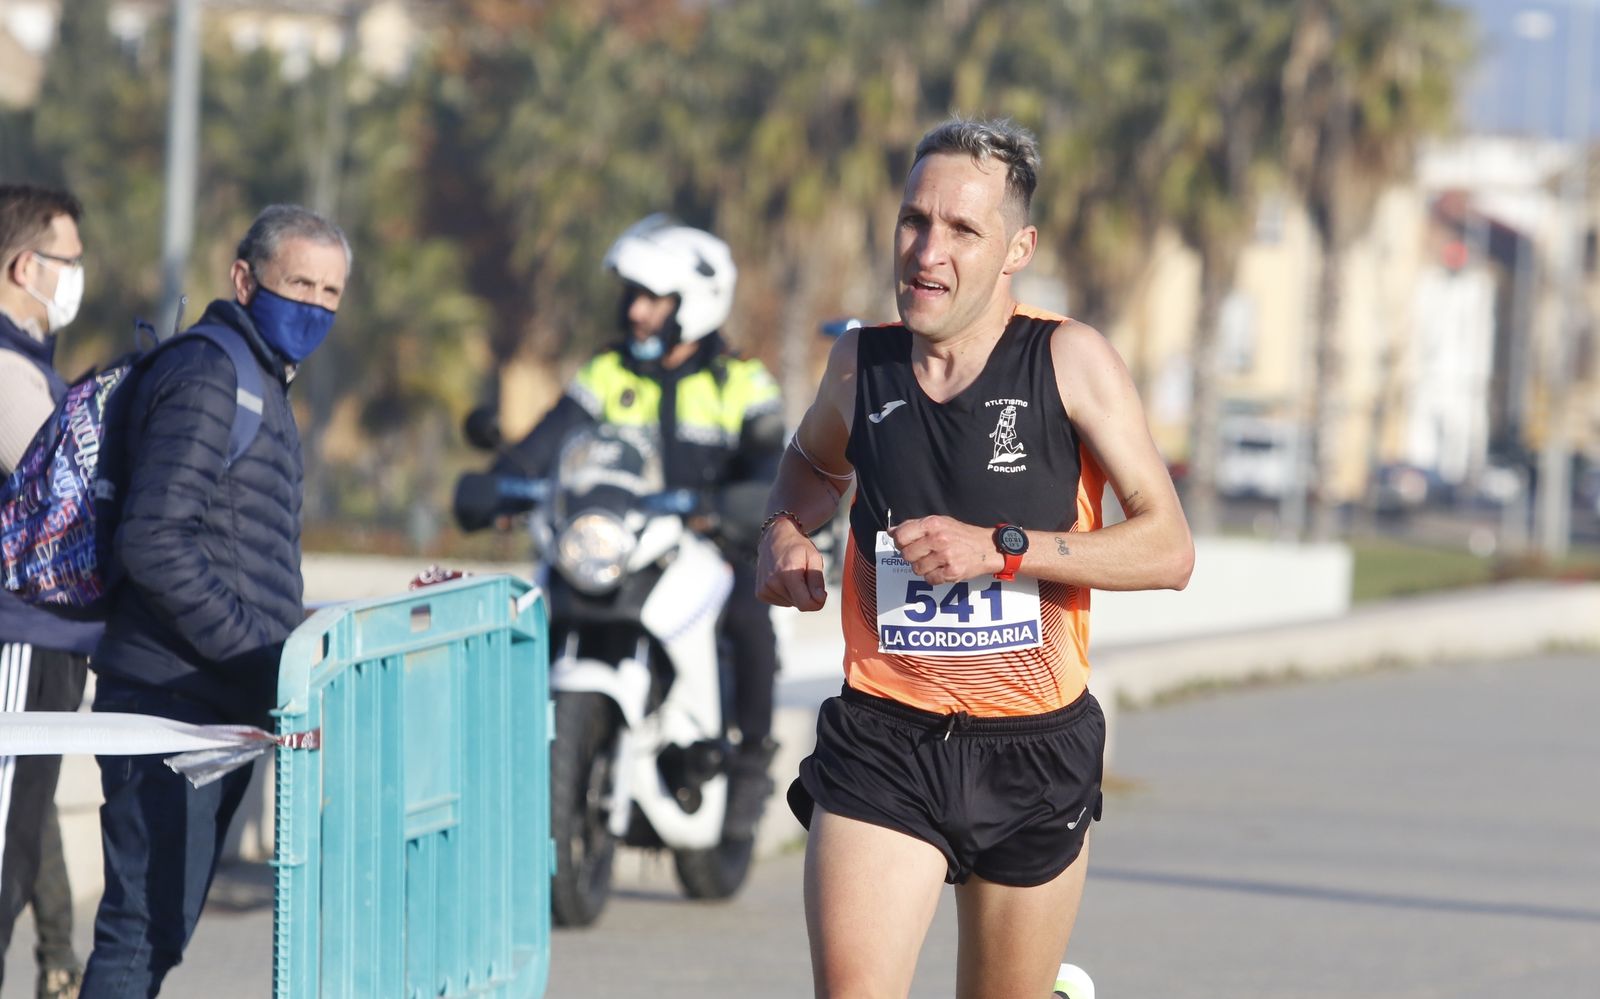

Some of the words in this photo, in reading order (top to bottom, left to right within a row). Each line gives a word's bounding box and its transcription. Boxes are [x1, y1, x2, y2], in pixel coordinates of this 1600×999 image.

[985, 398, 1028, 408] ATLETISMO
[987, 464, 1027, 473] PORCUNA
[904, 581, 1003, 623] 541
[884, 630, 905, 646] LA
[907, 625, 1034, 647] CORDOBARIA
